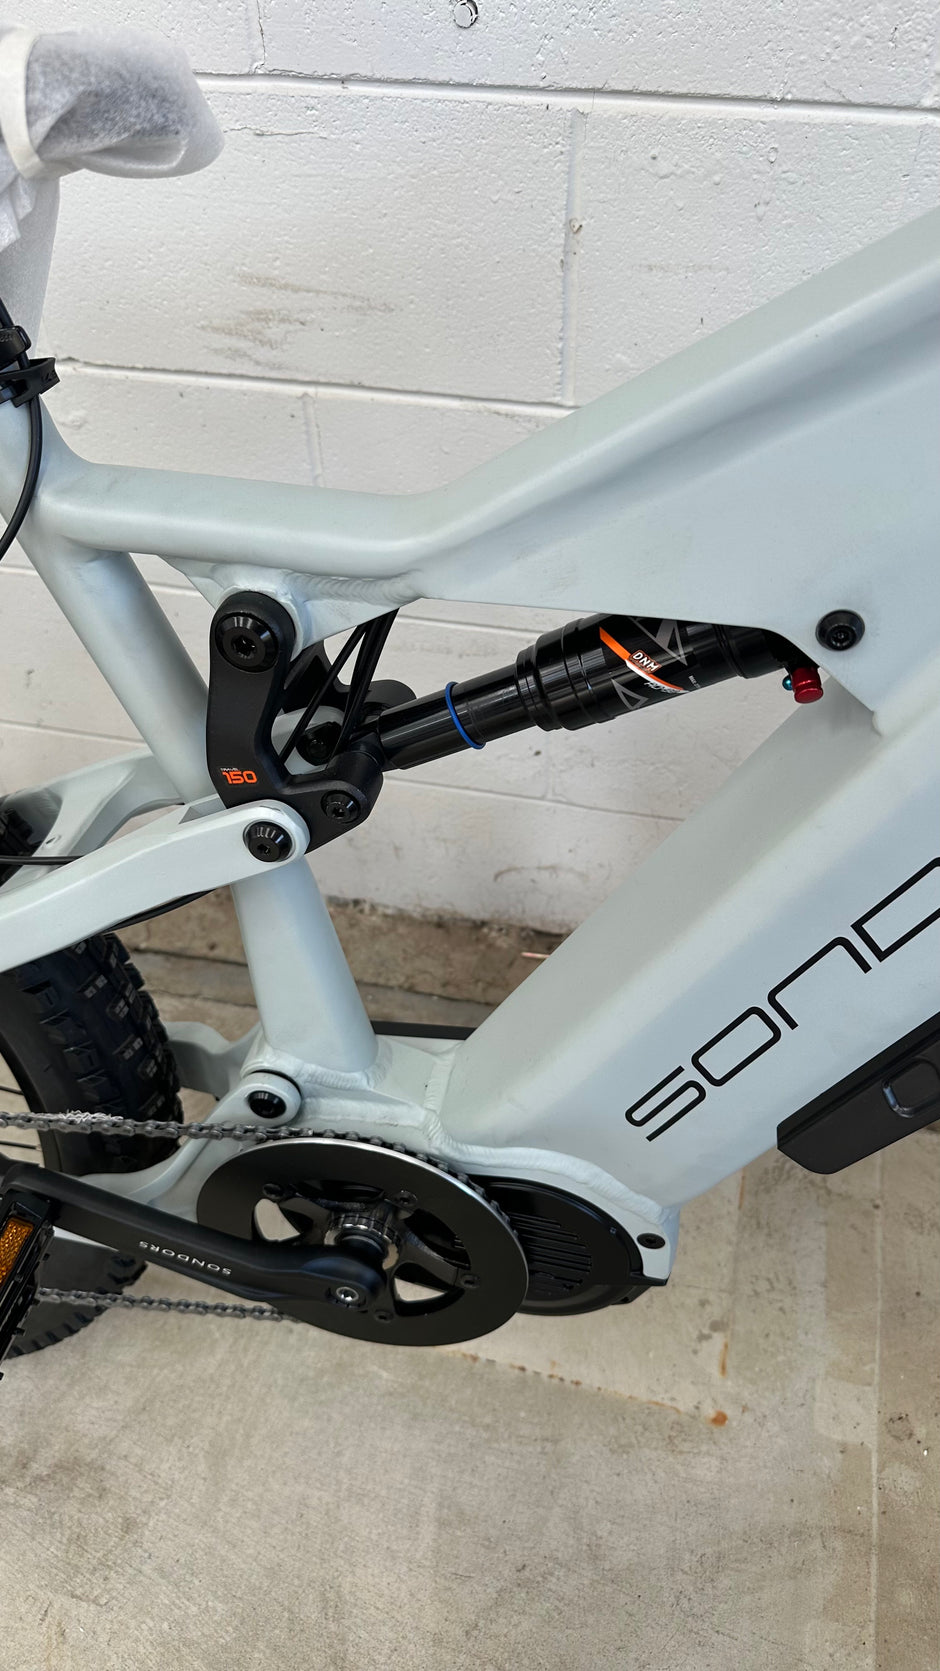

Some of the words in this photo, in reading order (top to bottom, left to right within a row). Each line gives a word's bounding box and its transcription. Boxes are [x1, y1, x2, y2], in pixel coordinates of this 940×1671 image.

[633, 652, 659, 672] DNM
[222, 770, 258, 784] 150
[139, 1241, 232, 1275] SONDORS
